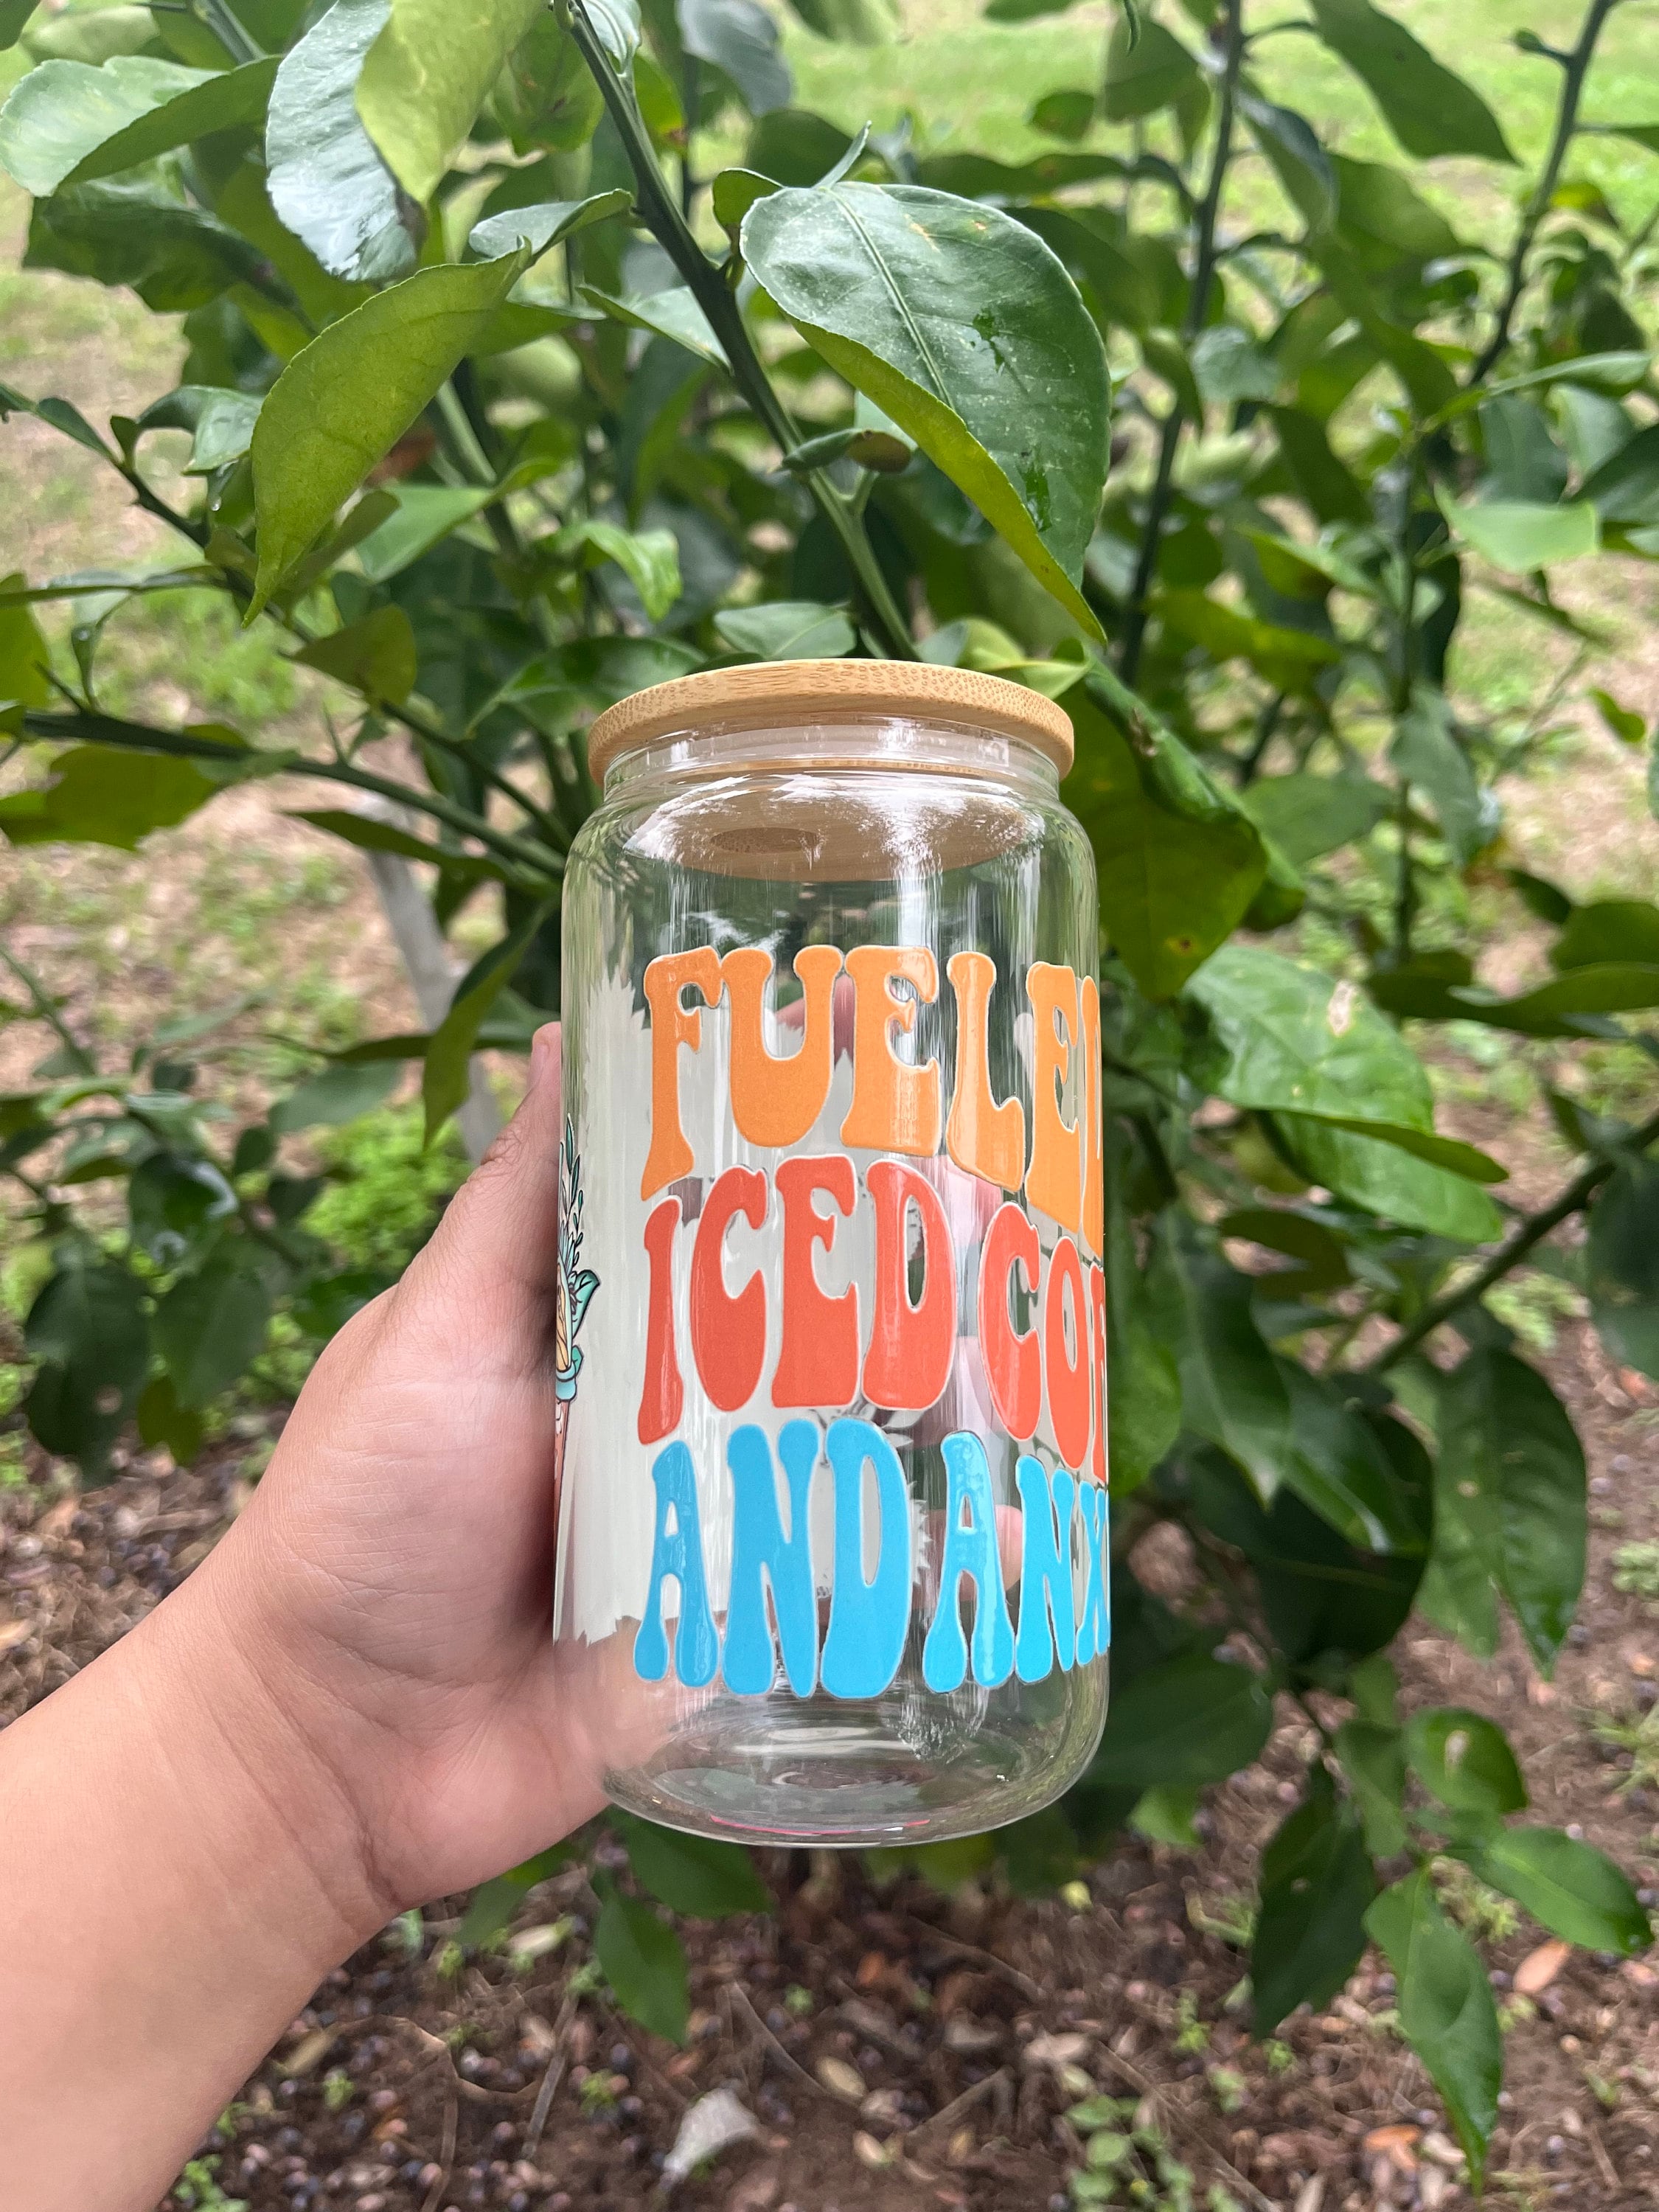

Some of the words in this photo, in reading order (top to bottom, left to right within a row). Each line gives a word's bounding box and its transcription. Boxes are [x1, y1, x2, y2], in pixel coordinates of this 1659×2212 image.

[638, 1155, 956, 1444] ICED
[633, 1418, 912, 1699] AND
[922, 1430, 1110, 1693] ANX
